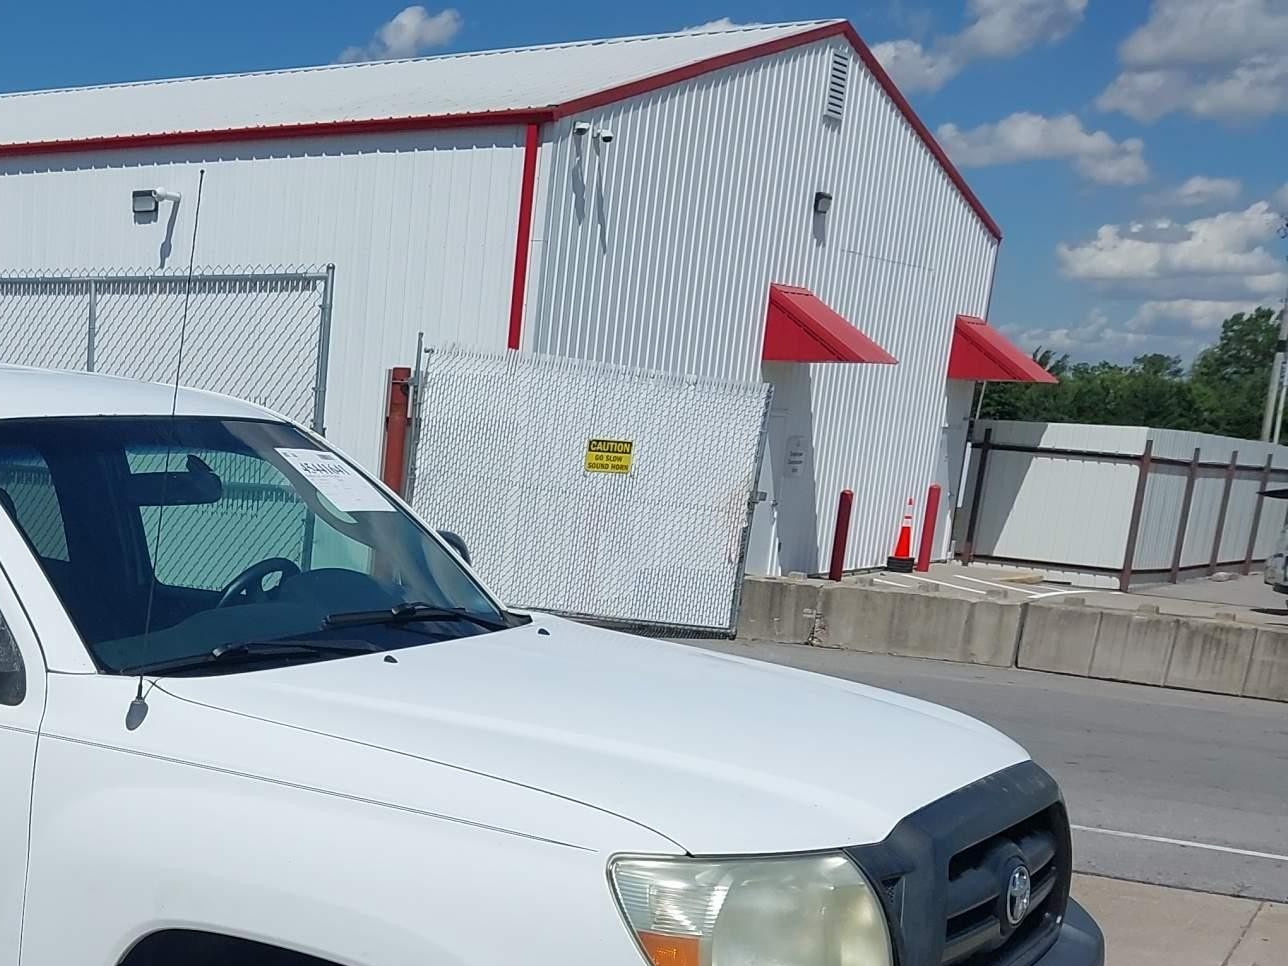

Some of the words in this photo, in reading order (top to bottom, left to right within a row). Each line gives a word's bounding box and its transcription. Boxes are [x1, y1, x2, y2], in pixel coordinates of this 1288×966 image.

[590, 441, 631, 453] CAUTION
[605, 455, 623, 463] SLOW
[587, 462, 610, 470] SOUND
[610, 463, 629, 471] HORN
